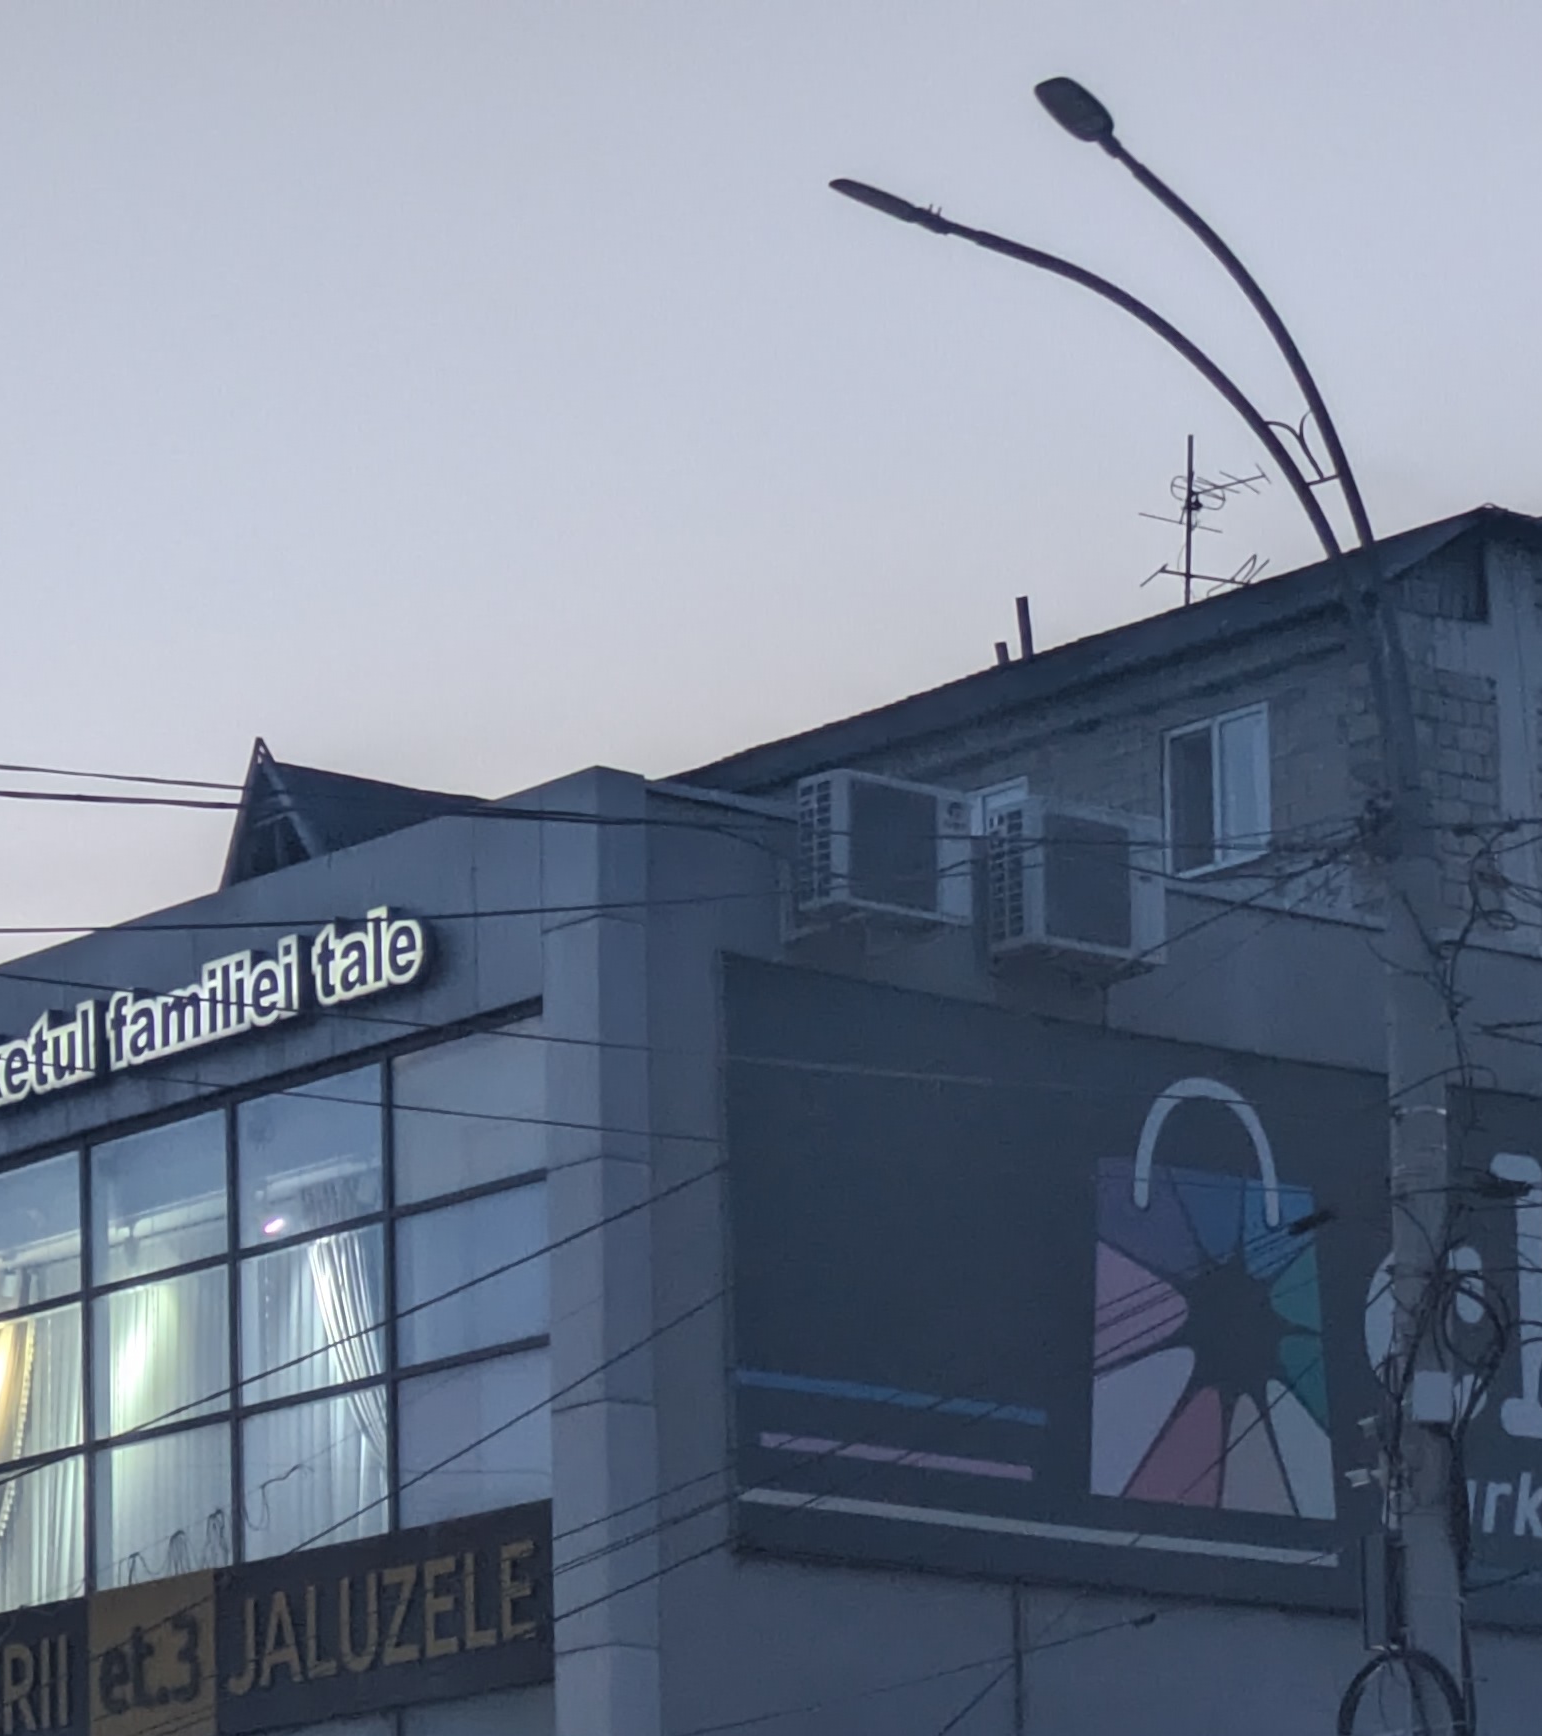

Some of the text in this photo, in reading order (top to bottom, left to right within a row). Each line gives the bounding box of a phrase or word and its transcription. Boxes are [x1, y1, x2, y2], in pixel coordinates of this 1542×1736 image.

[106, 933, 301, 1071] familiei
[311, 905, 424, 1008] tale
[222, 1538, 538, 1697] JALUZELE
